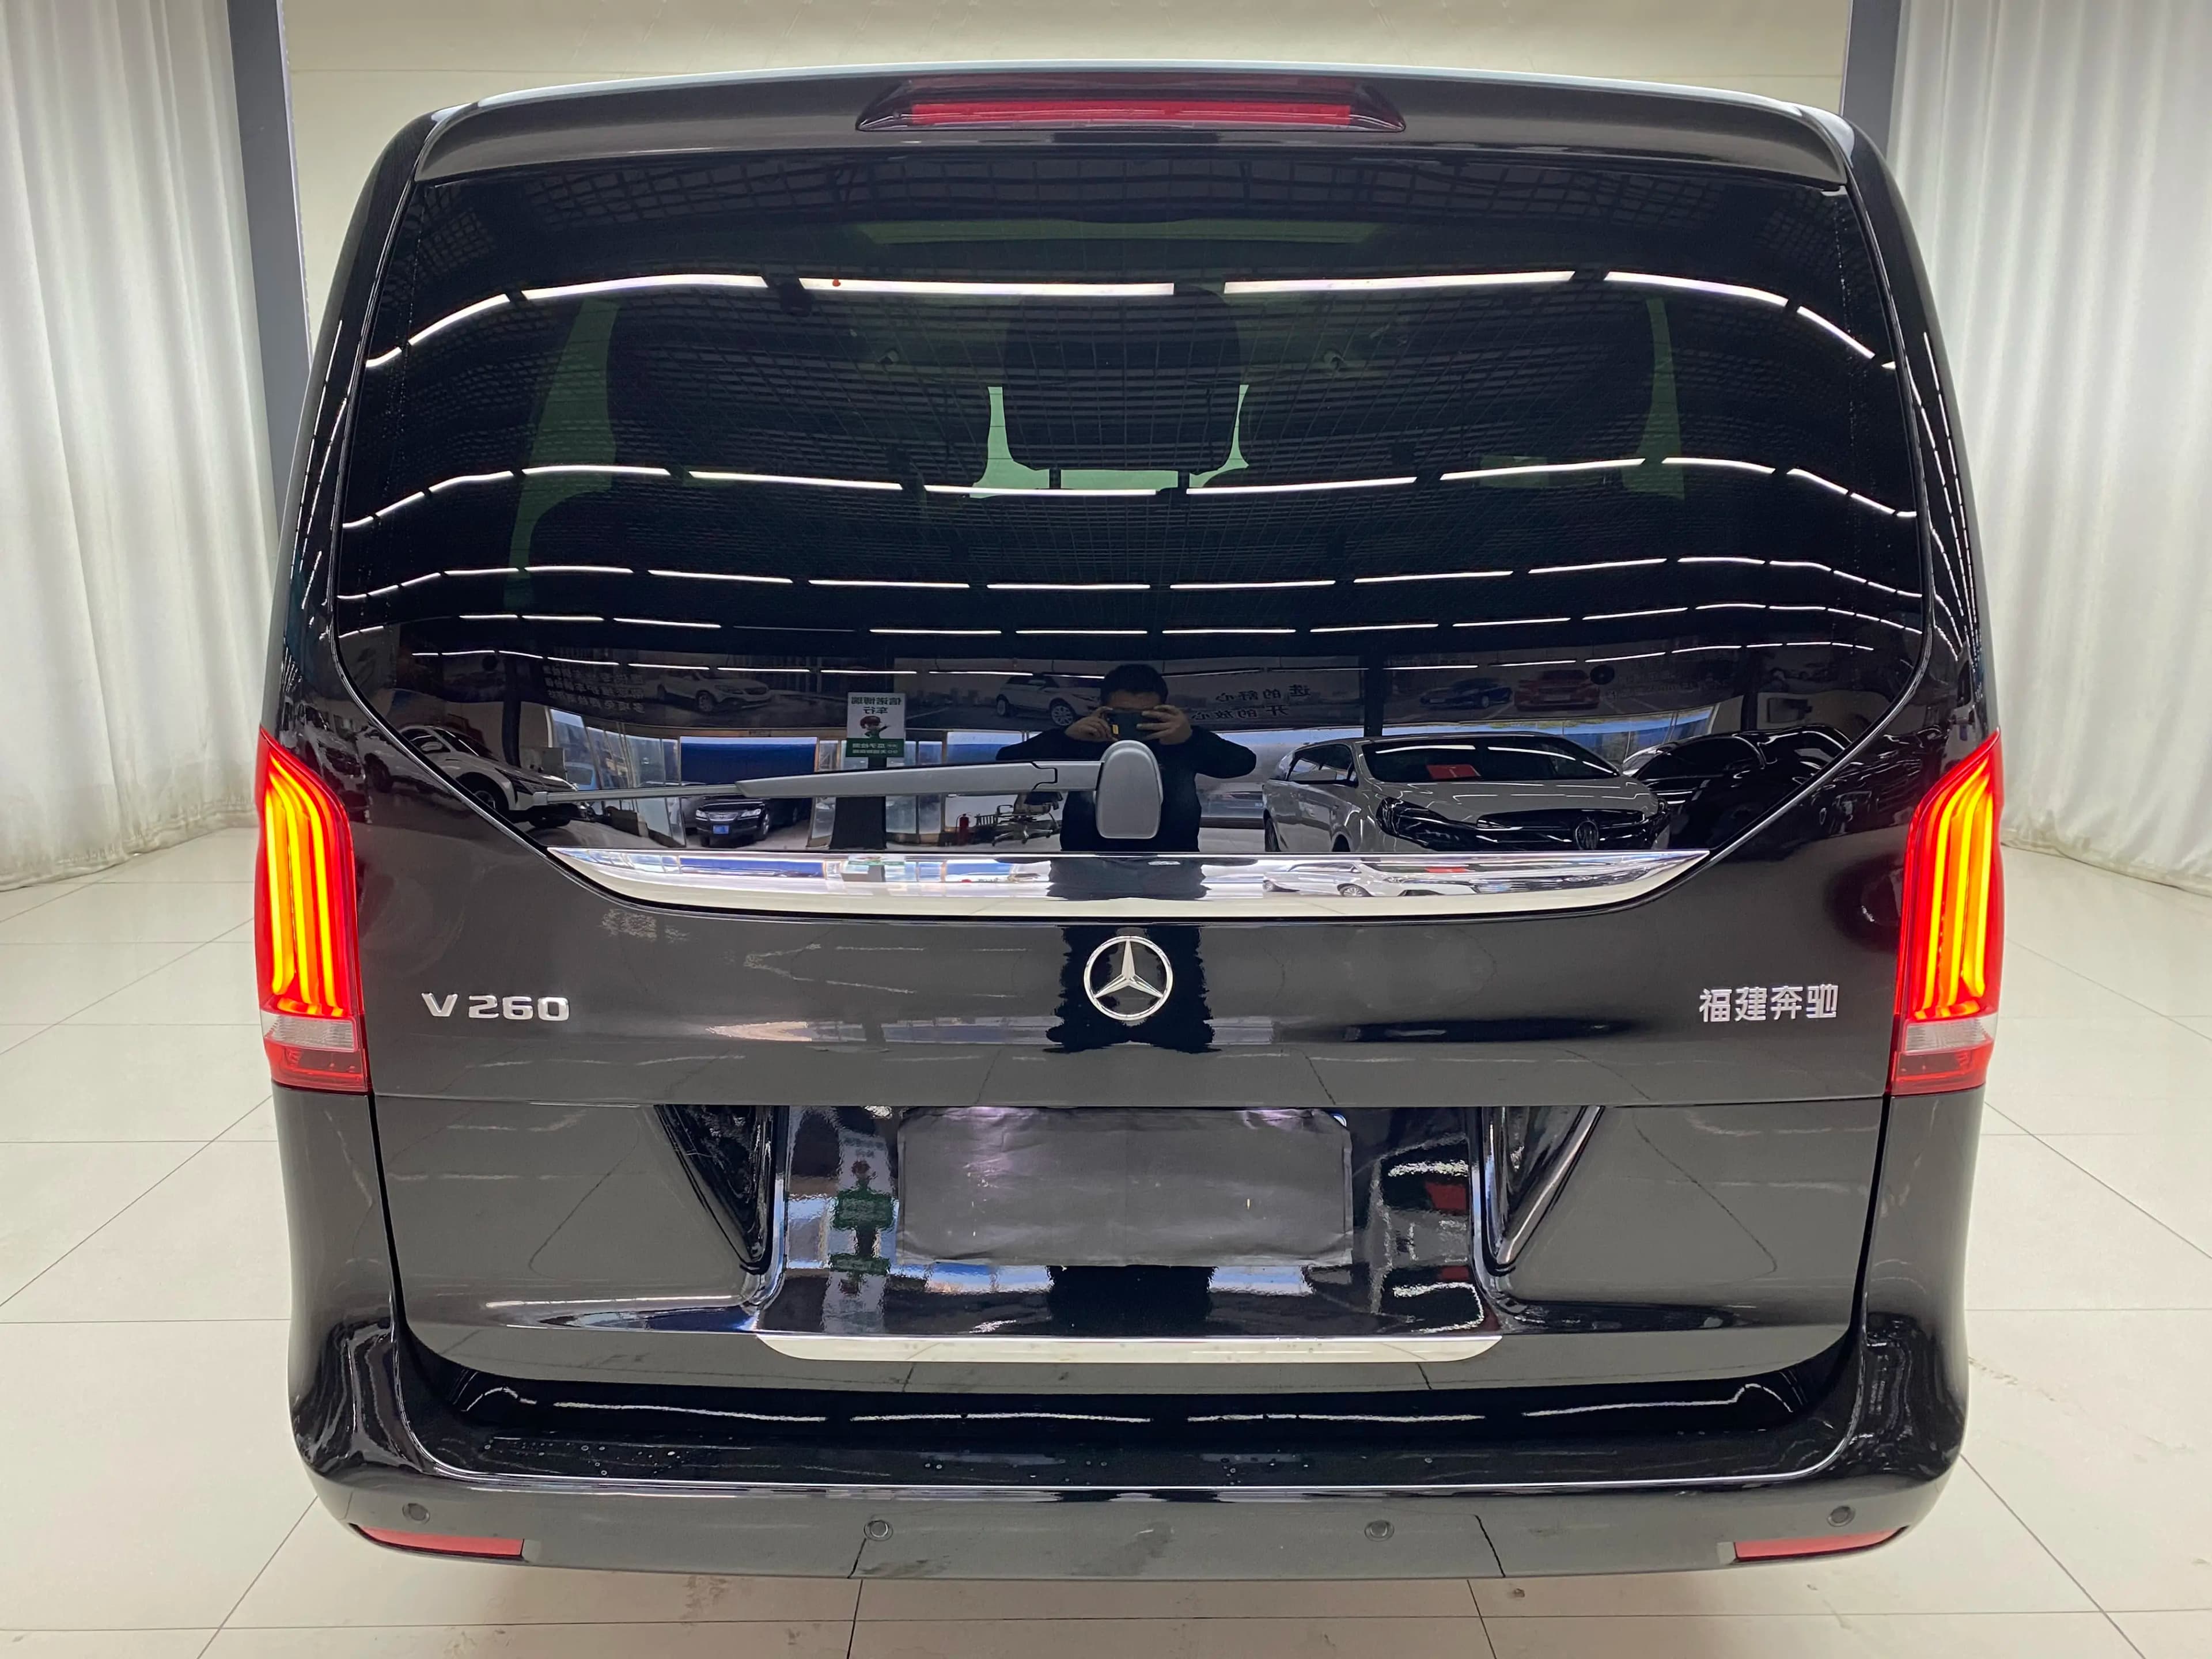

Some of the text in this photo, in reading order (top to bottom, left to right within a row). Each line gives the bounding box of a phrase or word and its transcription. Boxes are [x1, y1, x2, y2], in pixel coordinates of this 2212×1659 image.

[421, 991, 570, 1021] V 260
[1699, 983, 1839, 1023] 福建奔驰
